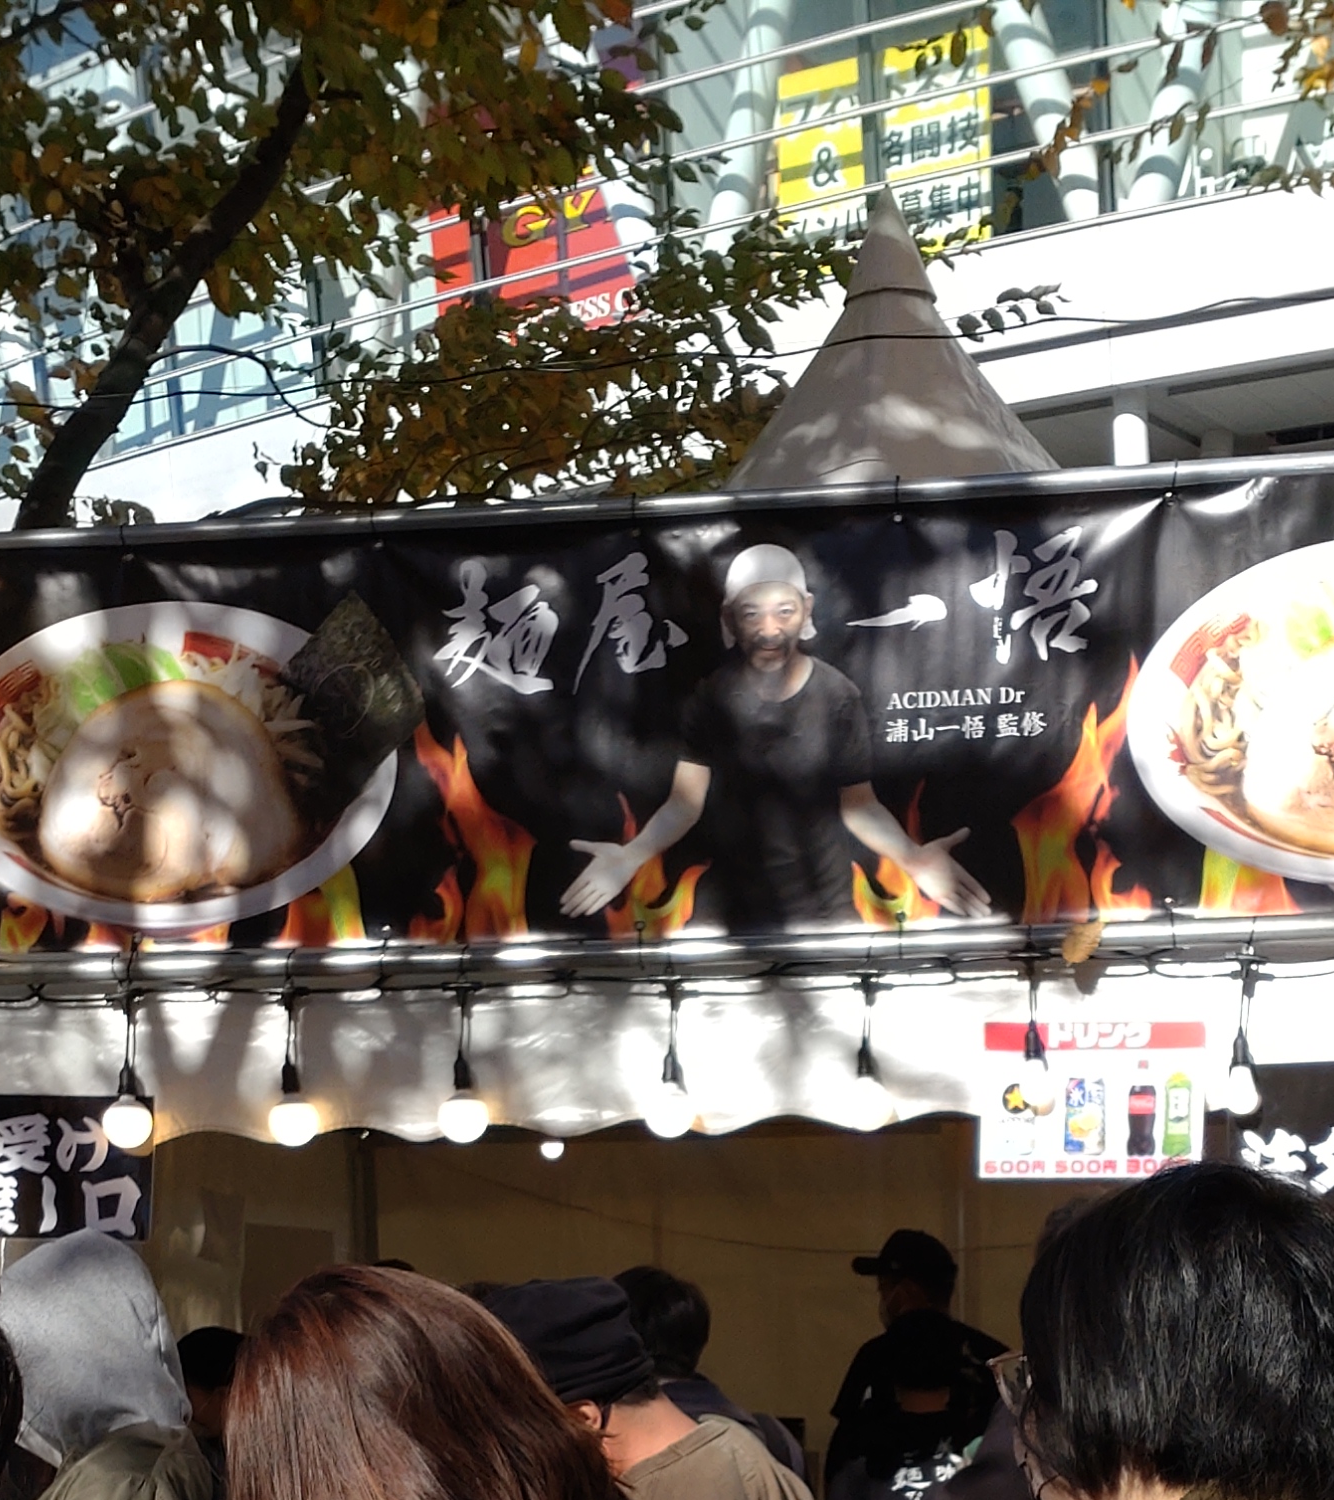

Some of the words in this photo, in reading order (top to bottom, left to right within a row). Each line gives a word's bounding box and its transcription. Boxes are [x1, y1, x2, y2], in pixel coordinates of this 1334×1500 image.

[813, 147, 839, 187] &
[886, 687, 993, 710] ACIDMAN
[999, 686, 1026, 704] Dr
[885, 714, 986, 743] 浦山一悟
[996, 710, 1048, 738] 監修
[1048, 1022, 1152, 1050] ドリンク
[984, 1159, 1046, 1174] 600円
[1055, 1159, 1117, 1174] 500円
